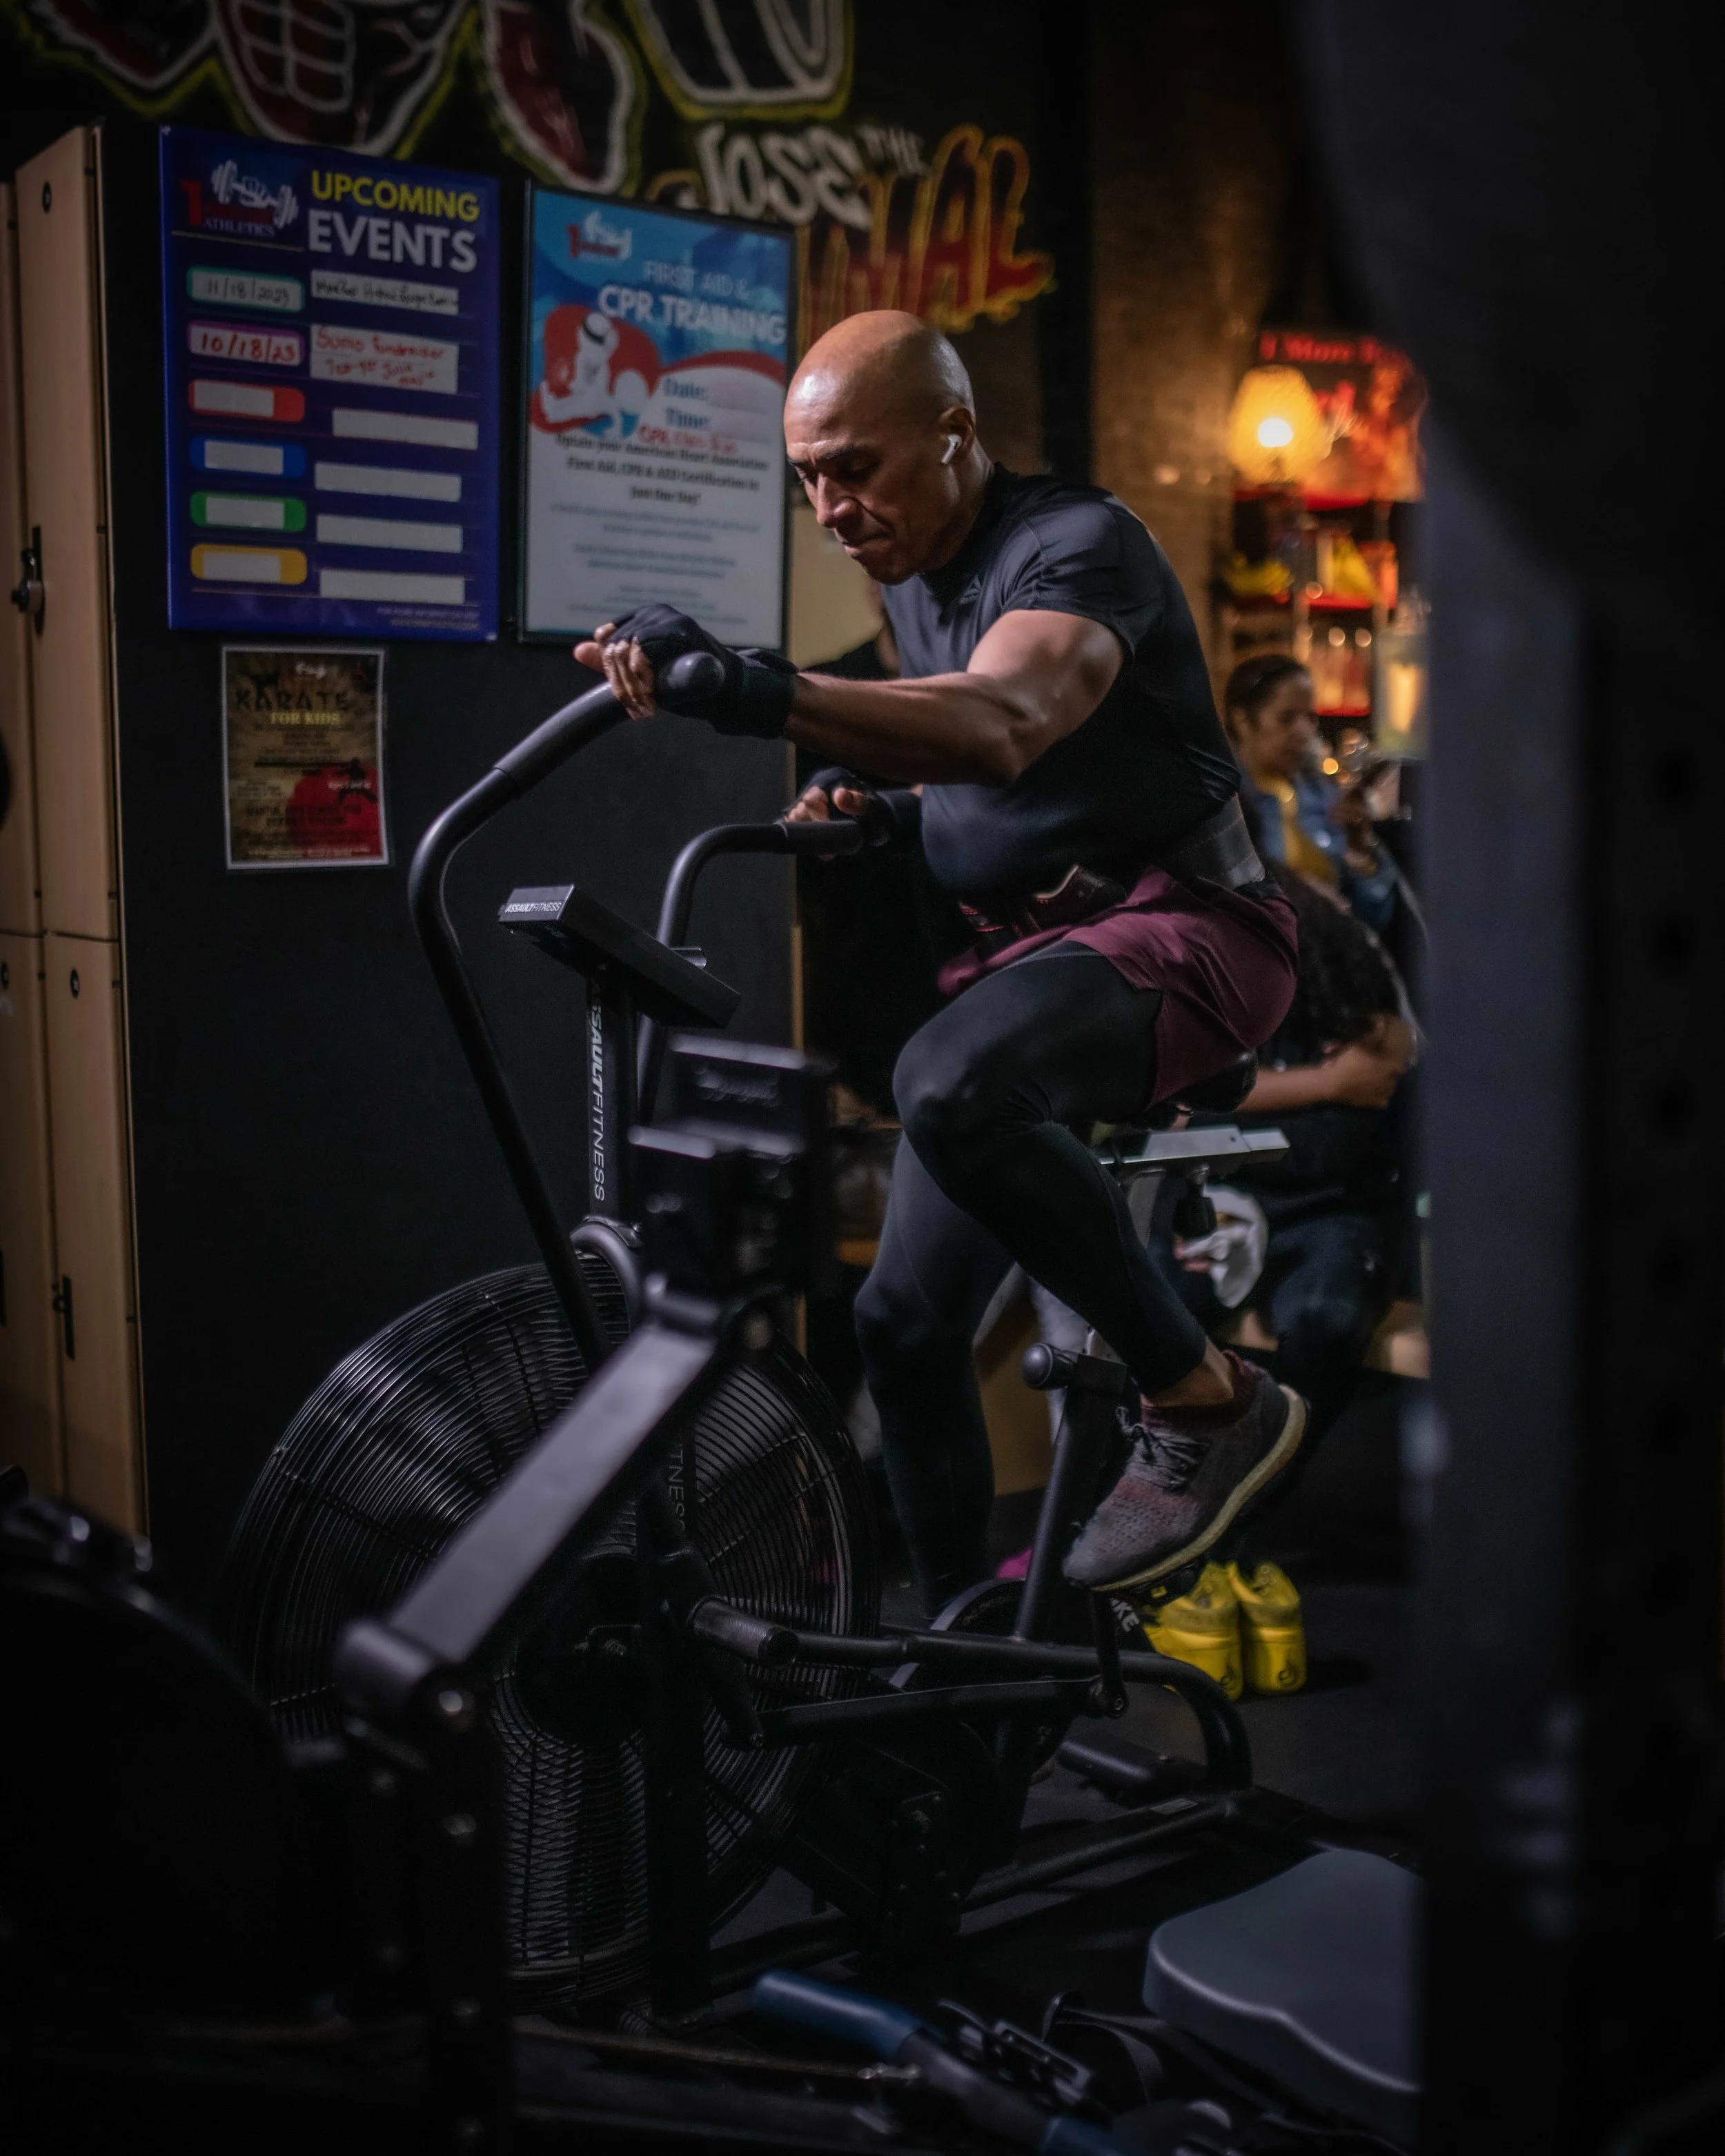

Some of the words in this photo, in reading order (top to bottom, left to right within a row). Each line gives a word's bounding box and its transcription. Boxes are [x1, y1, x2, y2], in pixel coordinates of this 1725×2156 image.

[311, 169, 481, 222] UPCOMING
[205, 217, 275, 238] ATHLETICS
[308, 208, 477, 273] EVENTS
[643, 259, 695, 291] FIRST
[700, 272, 733, 297] AID
[598, 284, 653, 322] CPR
[660, 294, 787, 345] TRAINING
[235, 690, 347, 711] KARATE
[270, 711, 301, 725] FOR
[304, 711, 341, 725] KIDS
